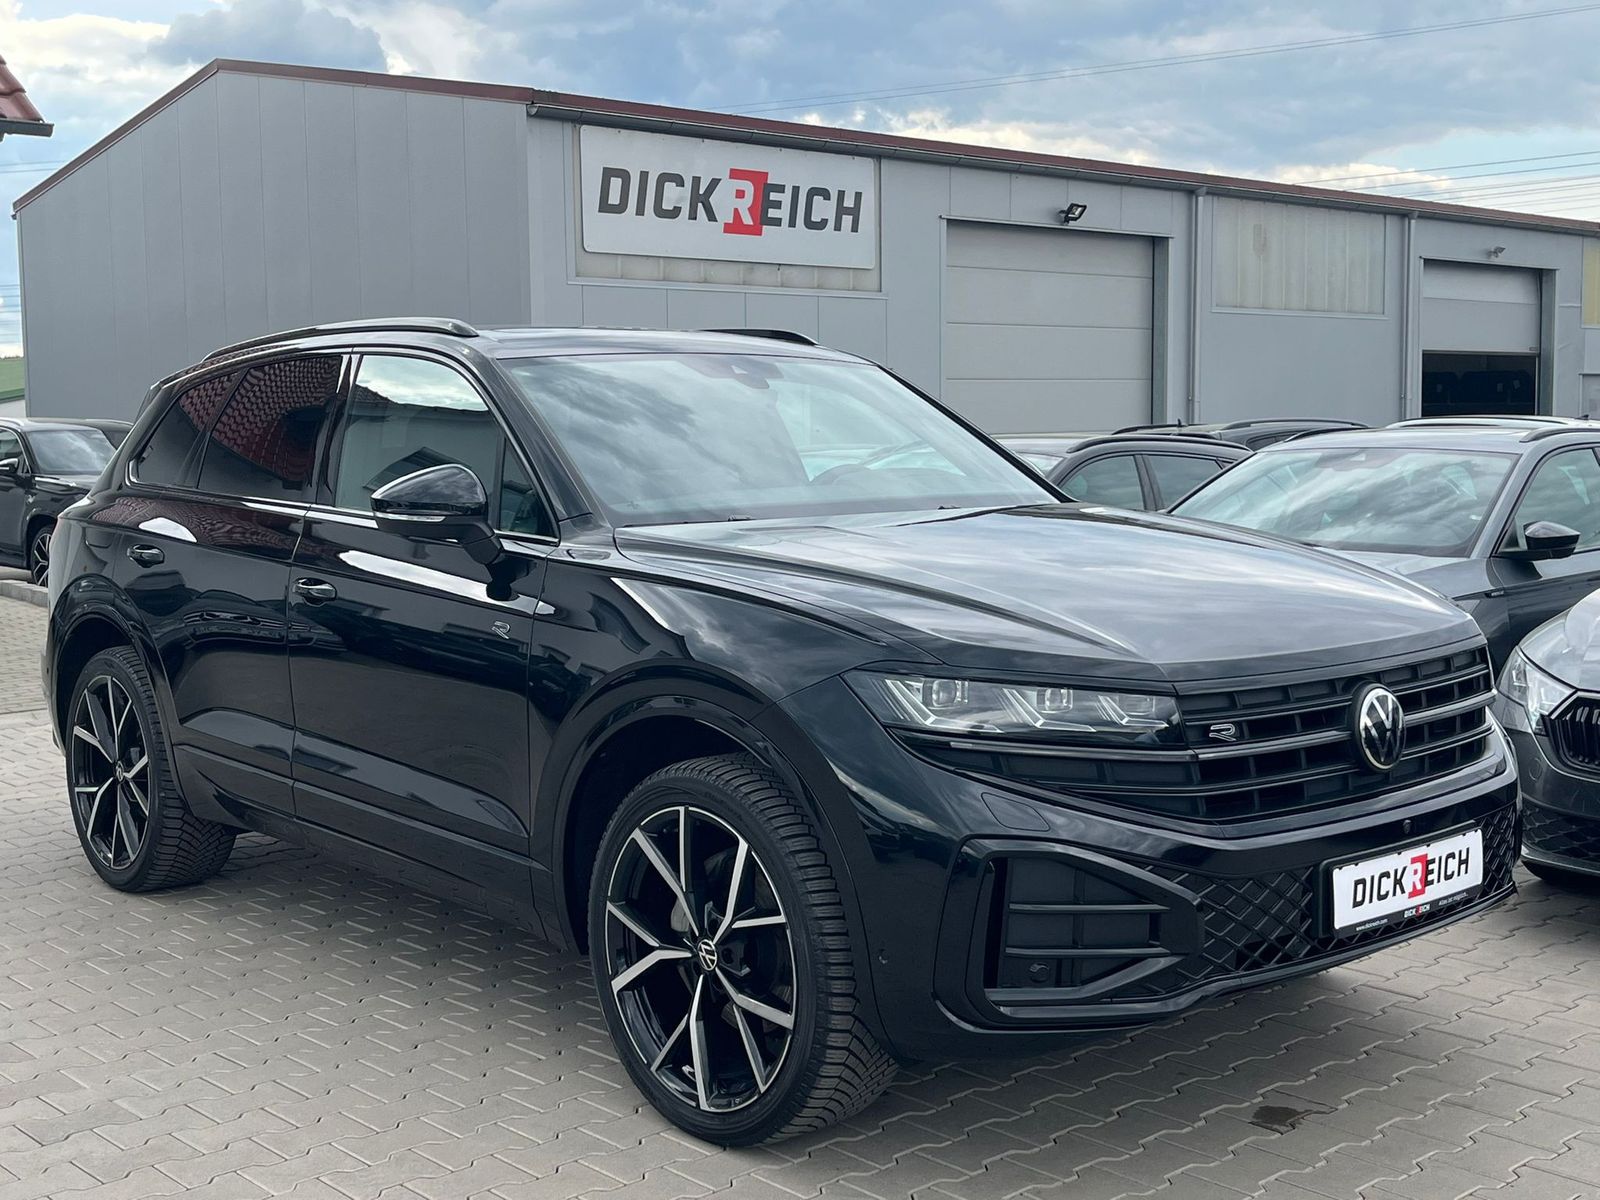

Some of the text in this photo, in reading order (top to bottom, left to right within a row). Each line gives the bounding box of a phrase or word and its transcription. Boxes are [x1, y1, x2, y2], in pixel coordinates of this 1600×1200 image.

[598, 167, 863, 236] DICKREICH
[1209, 723, 1236, 742] R
[1352, 847, 1470, 909] DICKREICH
